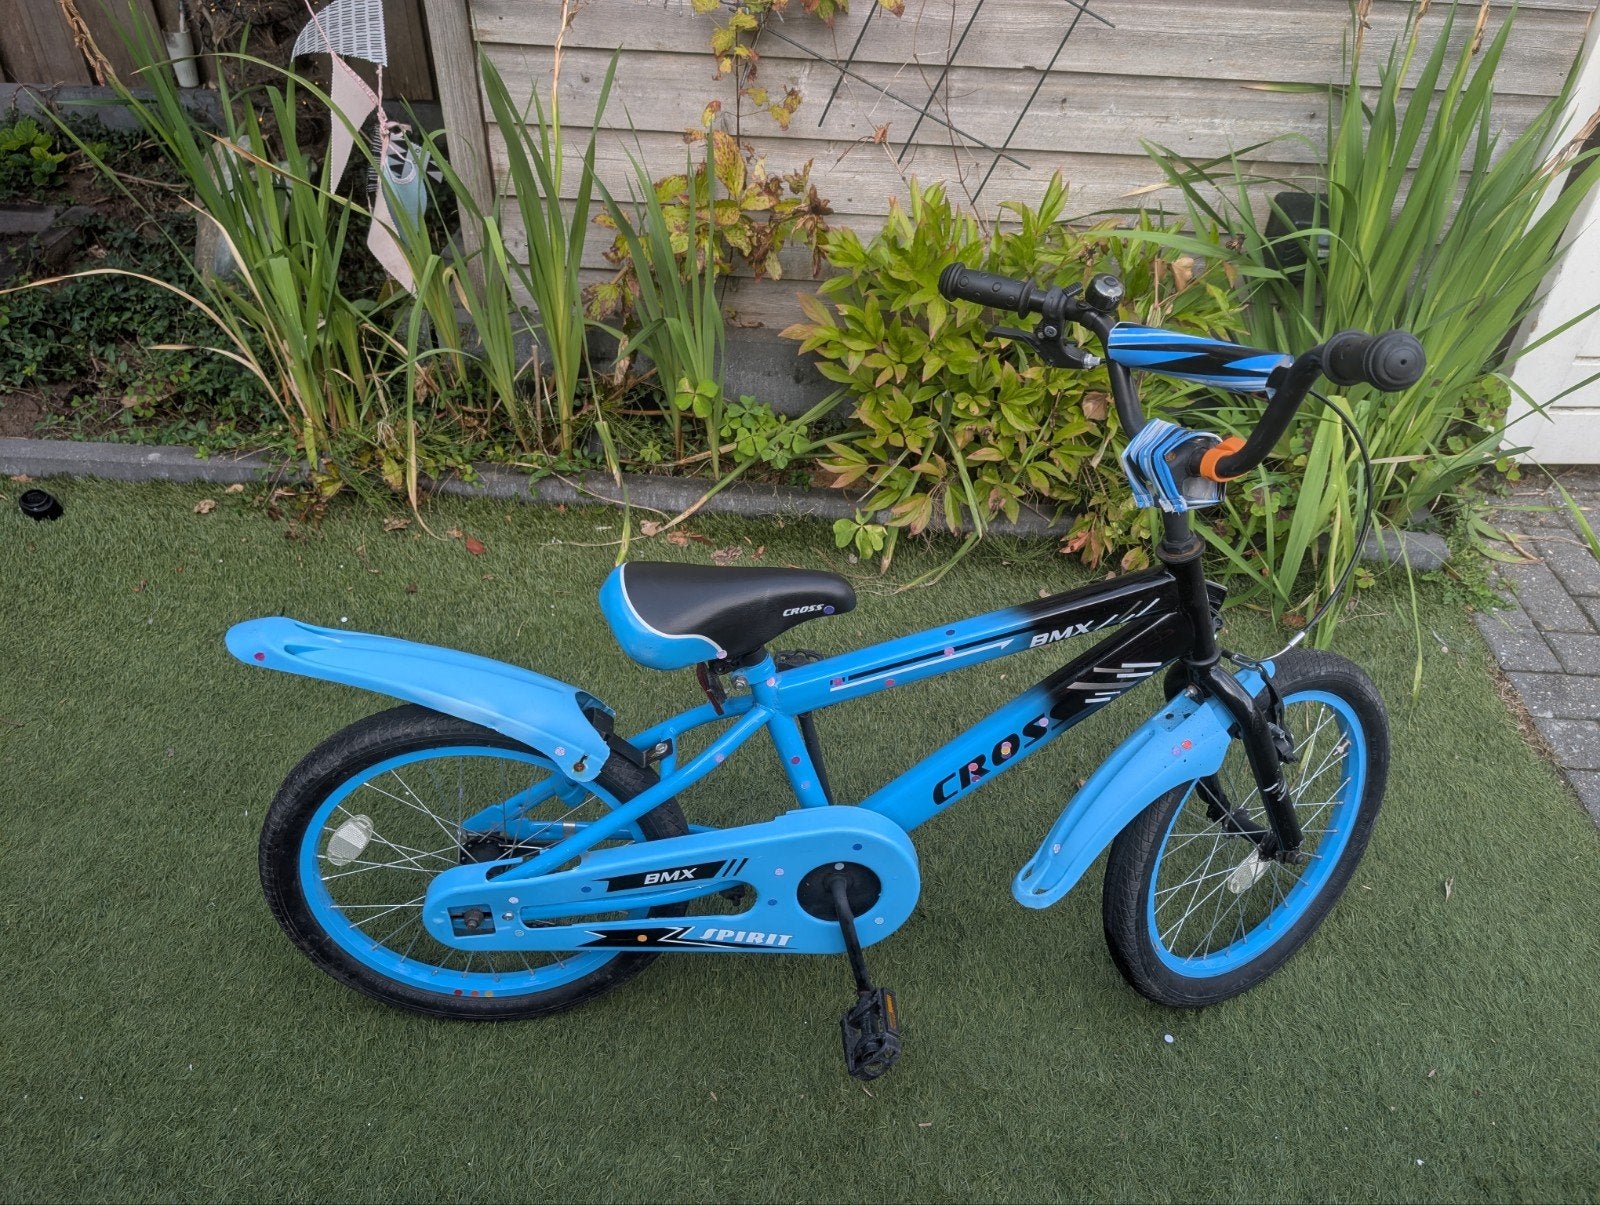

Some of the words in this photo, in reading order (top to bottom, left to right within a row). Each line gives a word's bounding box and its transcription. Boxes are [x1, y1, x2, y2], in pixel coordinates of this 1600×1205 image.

[783, 604, 824, 617] CROSS
[1030, 620, 1094, 648] BMX
[644, 868, 698, 885] BMX
[700, 928, 793, 947] SPIRIT
